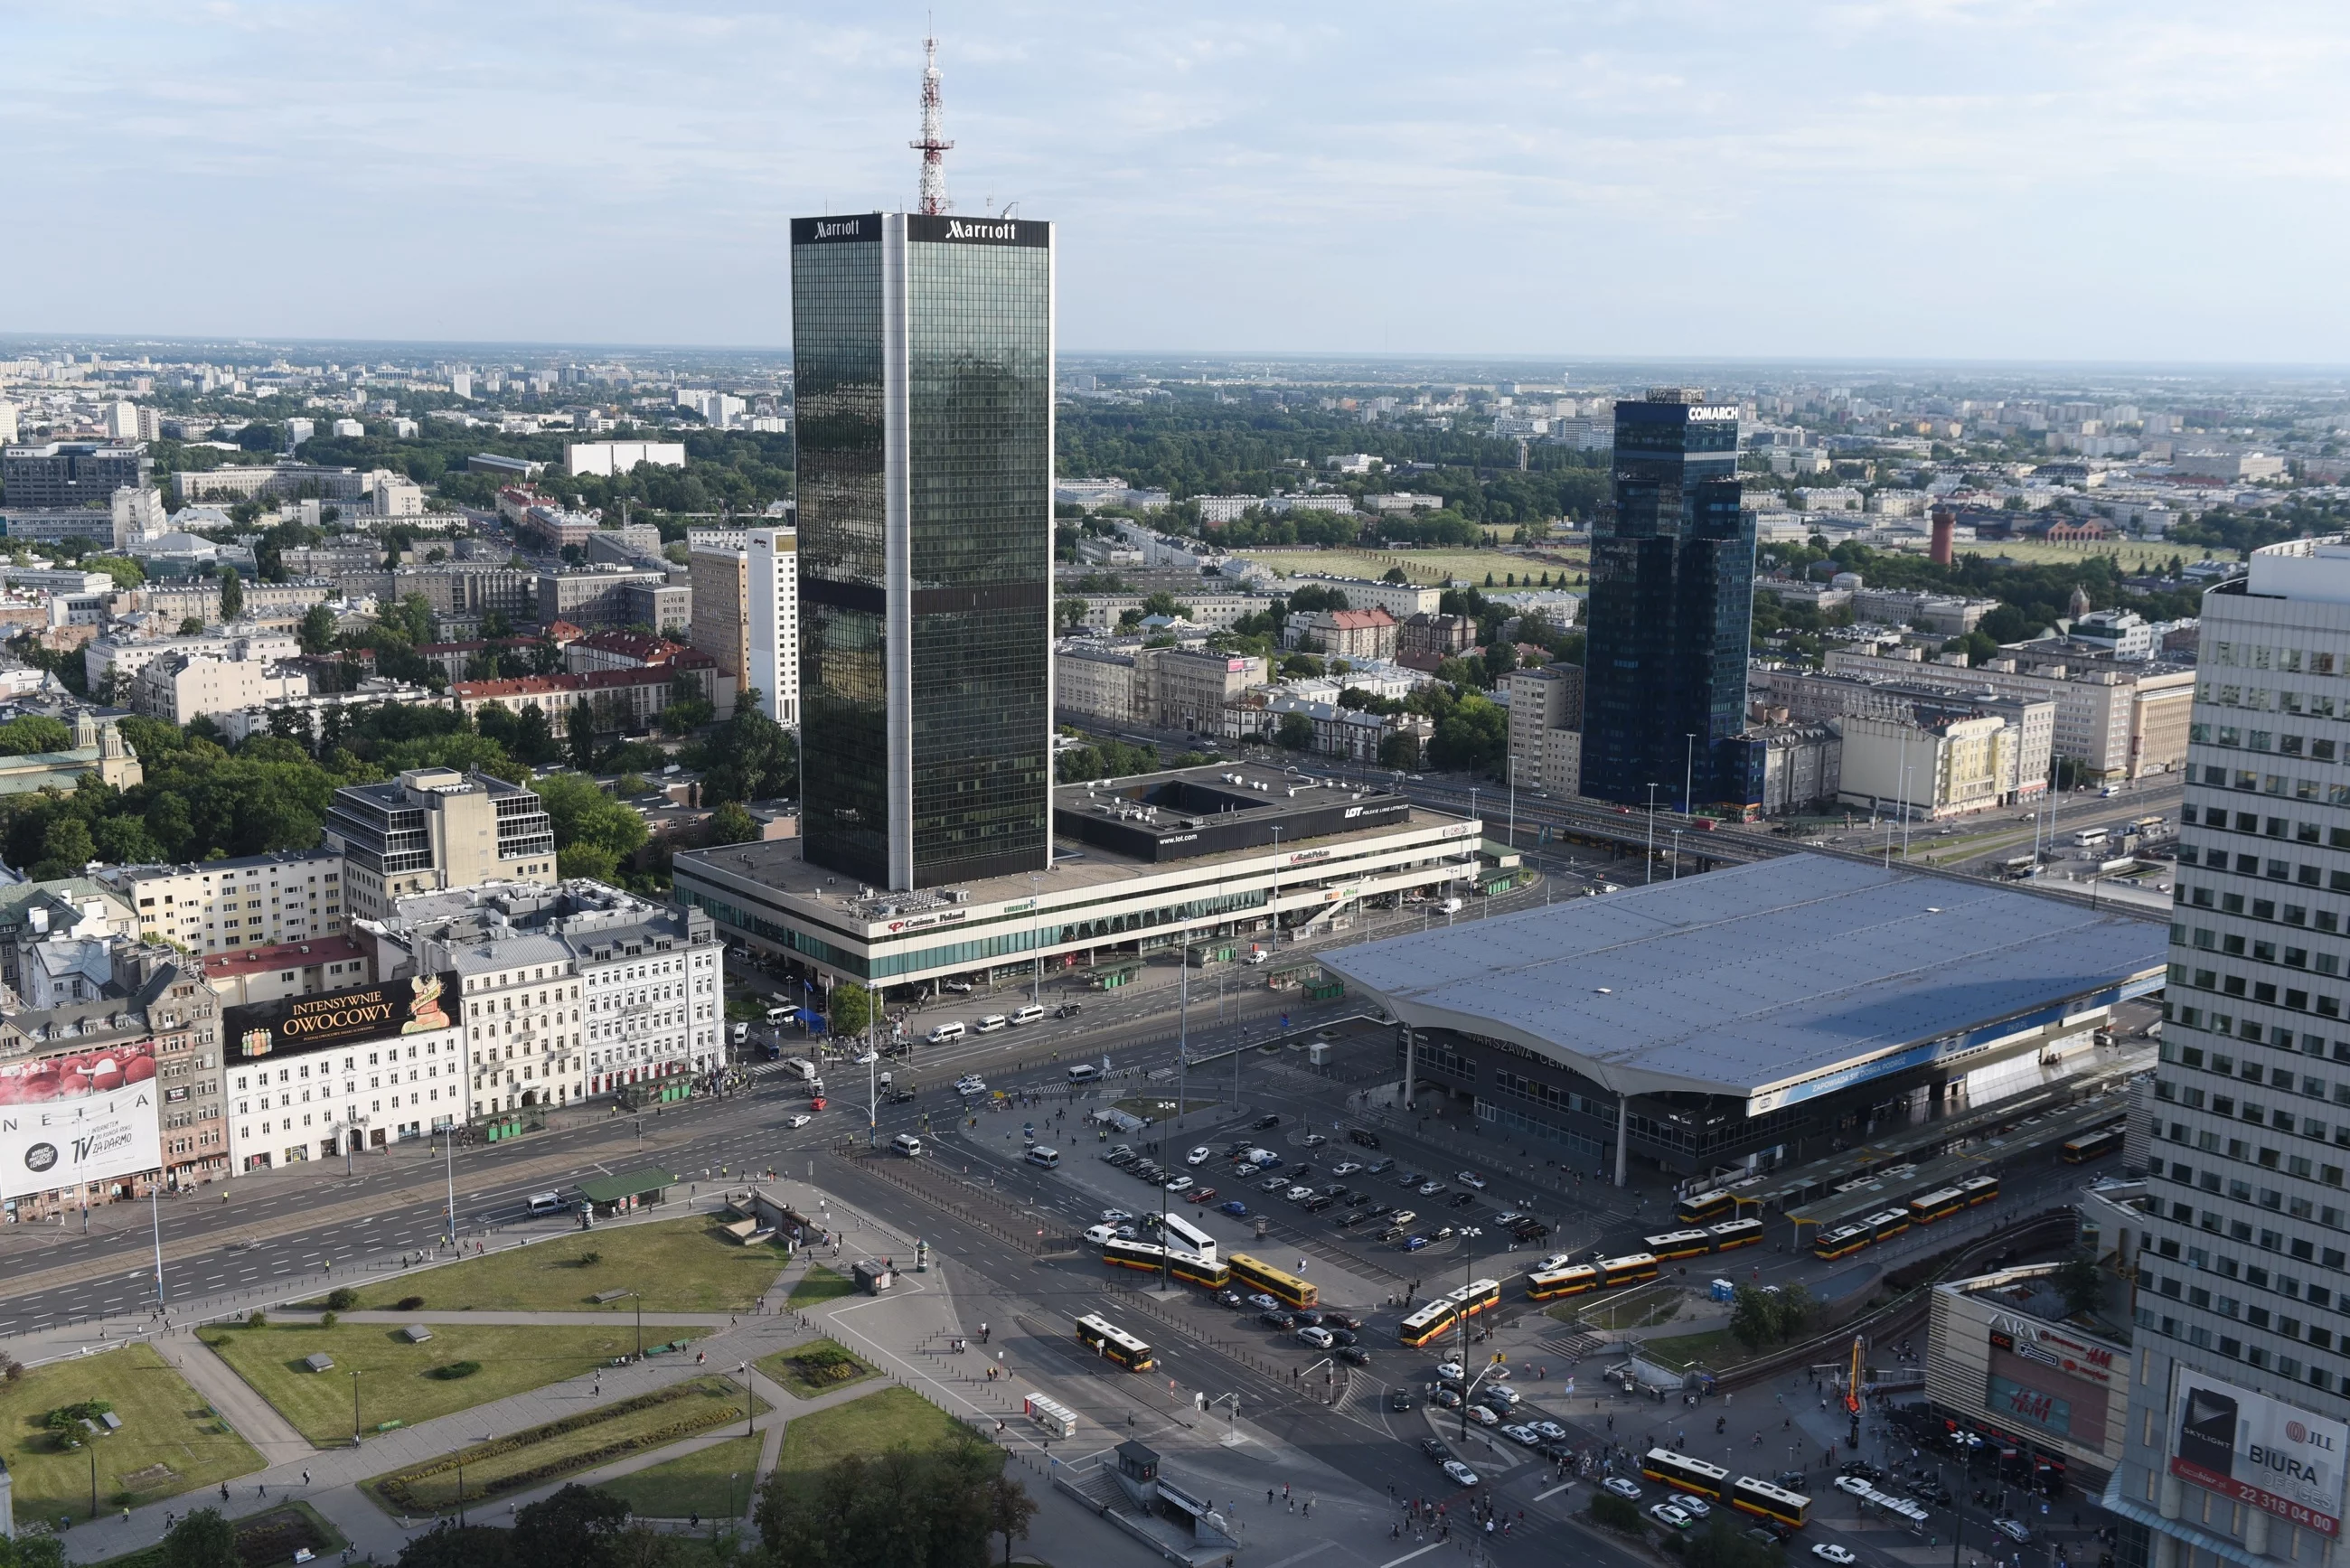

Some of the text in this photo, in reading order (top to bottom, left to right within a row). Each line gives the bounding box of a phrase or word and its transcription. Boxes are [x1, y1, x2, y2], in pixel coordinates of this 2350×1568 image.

[814, 220, 860, 239] Marriott
[945, 220, 1016, 239] Marriott
[1688, 406, 1739, 421] COMARCH
[1344, 806, 1364, 818] LOT
[1159, 834, 1198, 845] www.lot.com
[905, 909, 966, 929] Casinos Poland
[293, 991, 382, 1016] INTENSYWNIE
[283, 1002, 394, 1036] OWOCOWY
[4, 1094, 149, 1132] NETIA
[104, 1132, 132, 1150] DARMO
[1988, 1313, 2039, 1342] ZARA
[1991, 1335, 2010, 1347] CCC
[2086, 1347, 2112, 1369] H&M
[2009, 1387, 2053, 1424] H&M
[2183, 1426, 2231, 1450] SKYLIGHT
[2306, 1431, 2336, 1452] JLL
[2178, 1464, 2227, 1489] bazabiur.pl
[2249, 1443, 2318, 1487] BIURA
[2262, 1471, 2333, 1509] OFFICES
[2239, 1485, 2332, 1532] 22 318 04 00
